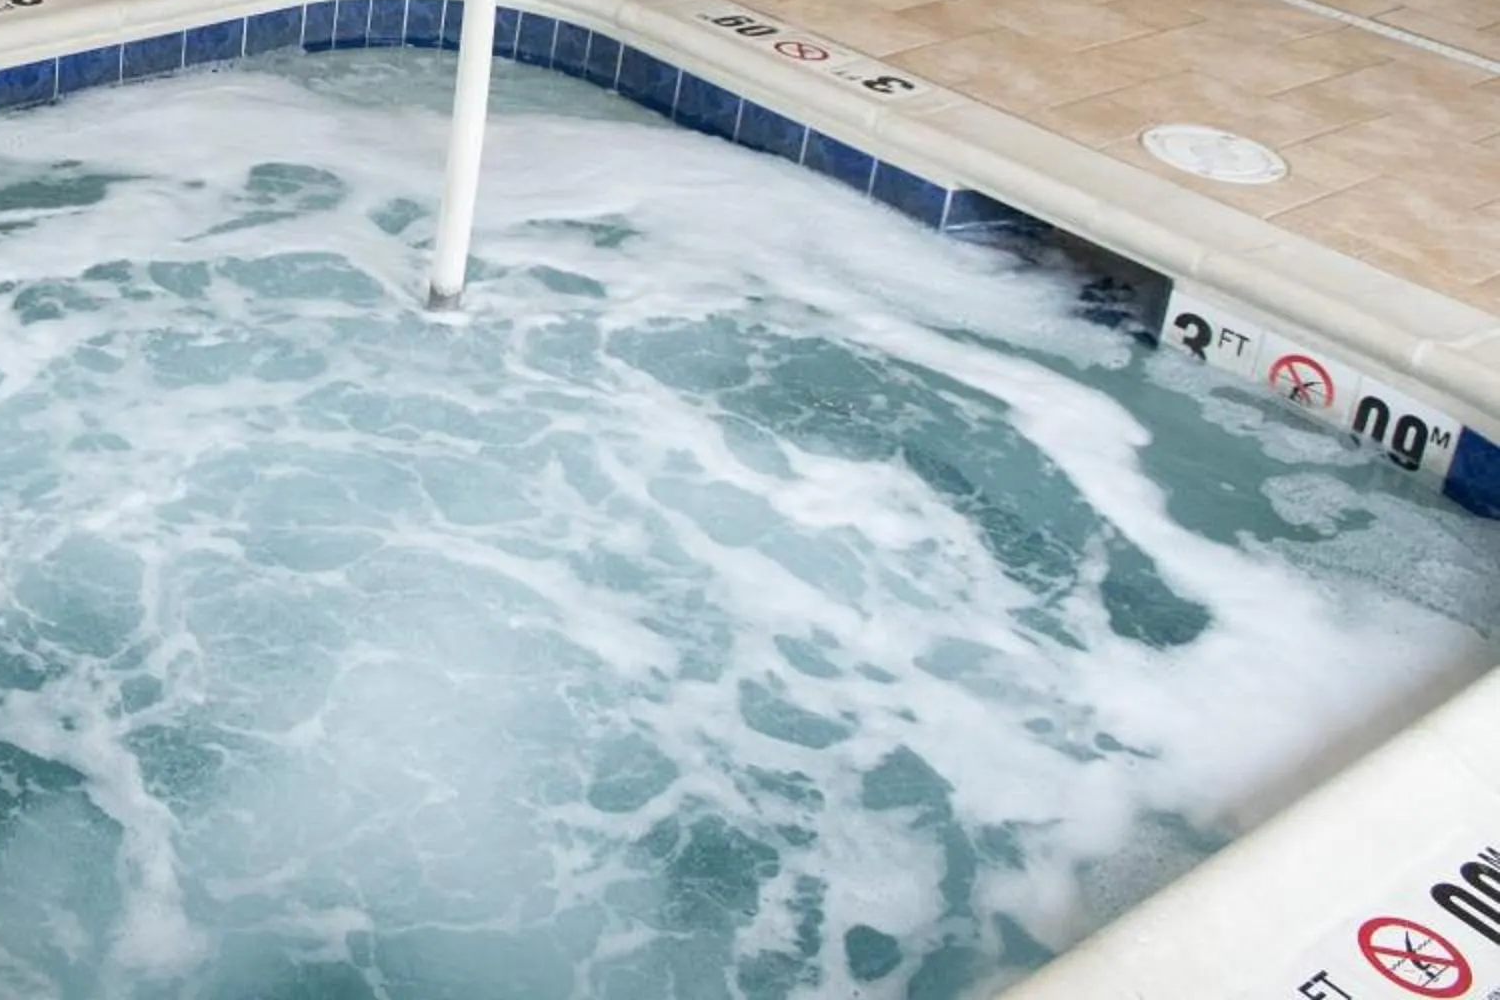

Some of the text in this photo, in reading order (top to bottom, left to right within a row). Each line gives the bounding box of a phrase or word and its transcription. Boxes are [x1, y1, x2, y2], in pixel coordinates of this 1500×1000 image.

[862, 75, 915, 94] 3
[1218, 327, 1251, 357] FT
[1430, 426, 1451, 449] M
